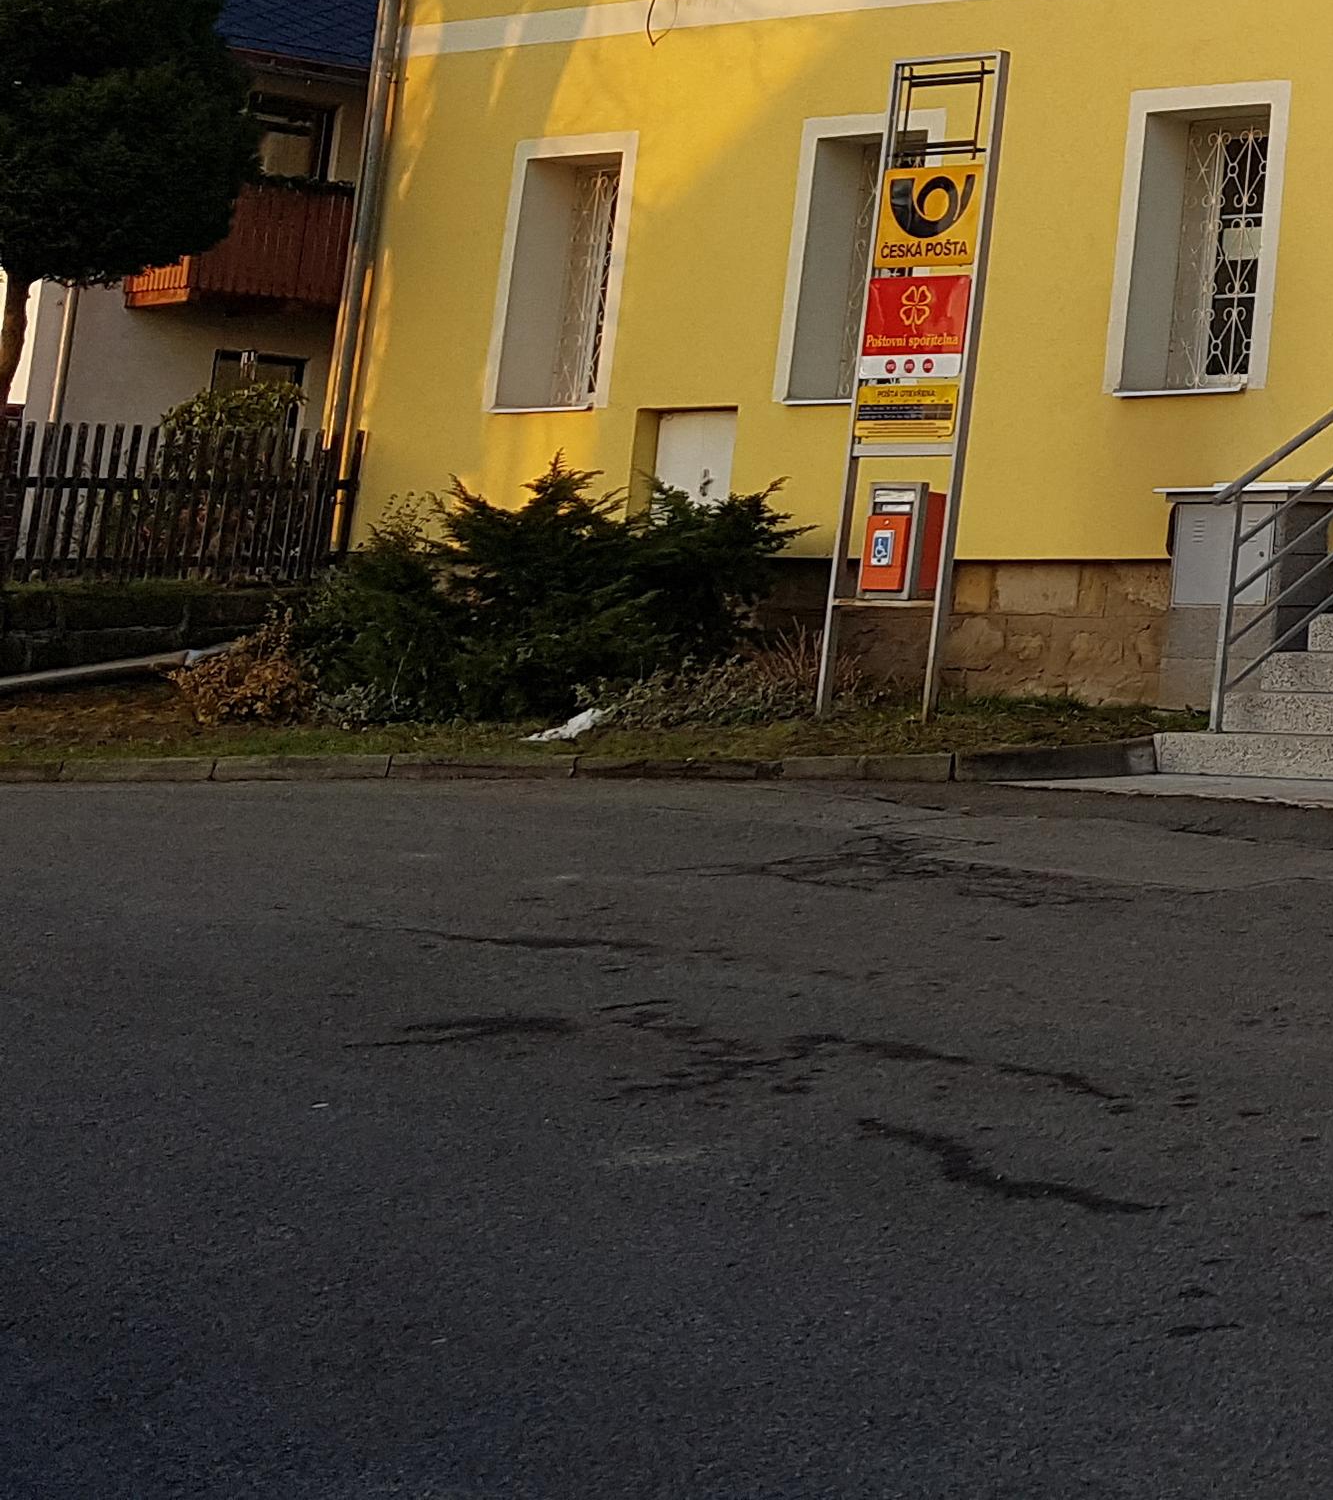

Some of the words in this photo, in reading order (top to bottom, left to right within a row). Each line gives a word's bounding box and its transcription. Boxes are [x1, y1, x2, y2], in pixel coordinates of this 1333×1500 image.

[881, 241, 922, 259] ČESKÁ
[925, 239, 968, 257] POŠTA
[866, 334, 907, 348] Poštovní
[908, 332, 959, 349] spořitelna
